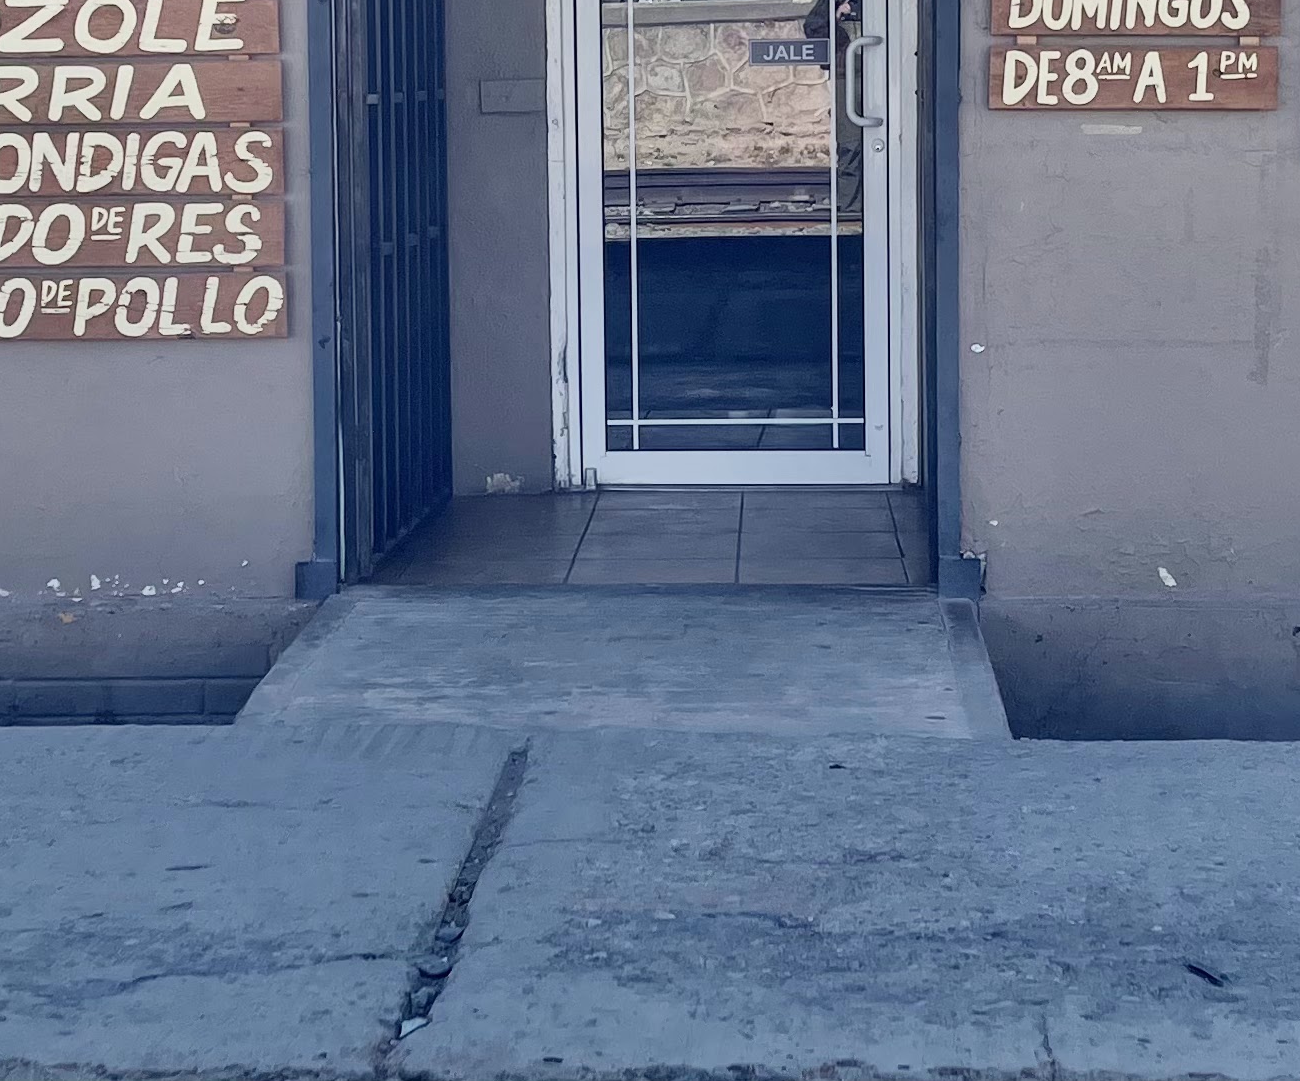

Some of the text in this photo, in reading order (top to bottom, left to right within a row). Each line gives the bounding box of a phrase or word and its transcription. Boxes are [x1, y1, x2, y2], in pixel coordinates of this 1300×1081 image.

[763, 45, 815, 60] JALE
[1133, 51, 1166, 103] A
[91, 206, 125, 238] DE
[125, 203, 262, 265] RES
[41, 279, 73, 310] DE
[74, 275, 283, 337] POLLO
